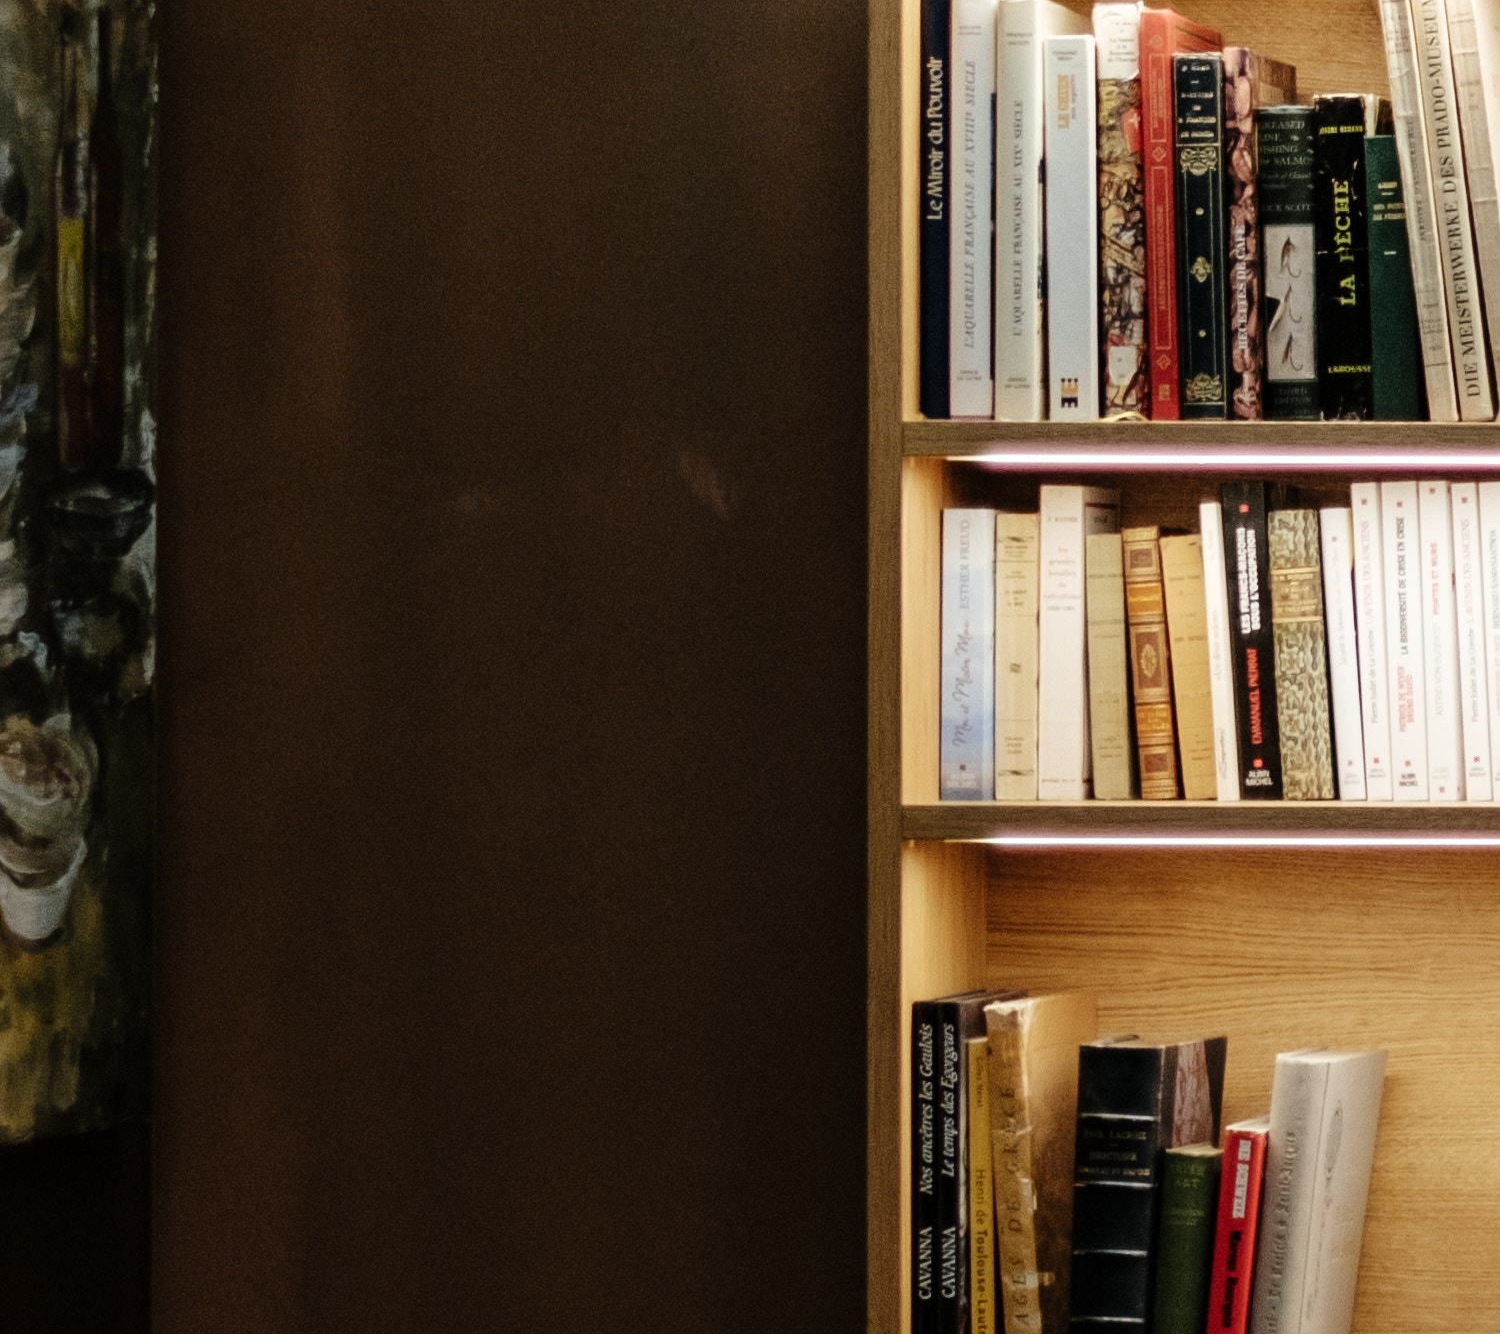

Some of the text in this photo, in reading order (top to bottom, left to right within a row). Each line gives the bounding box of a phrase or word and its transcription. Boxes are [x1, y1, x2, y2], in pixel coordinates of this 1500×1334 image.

[927, 57, 944, 221] Le Miroir du Pouvoir
[1440, 156, 1456, 193] DES
[1340, 274, 1356, 306] LA
[1445, 201, 1475, 364] MEISTERWERKE
[1467, 371, 1481, 398] DIE
[1247, 648, 1259, 686] PIERRAT
[919, 1024, 933, 1194] Nos ancêtres les Gaulois
[920, 1227, 932, 1299] CAVANNA
